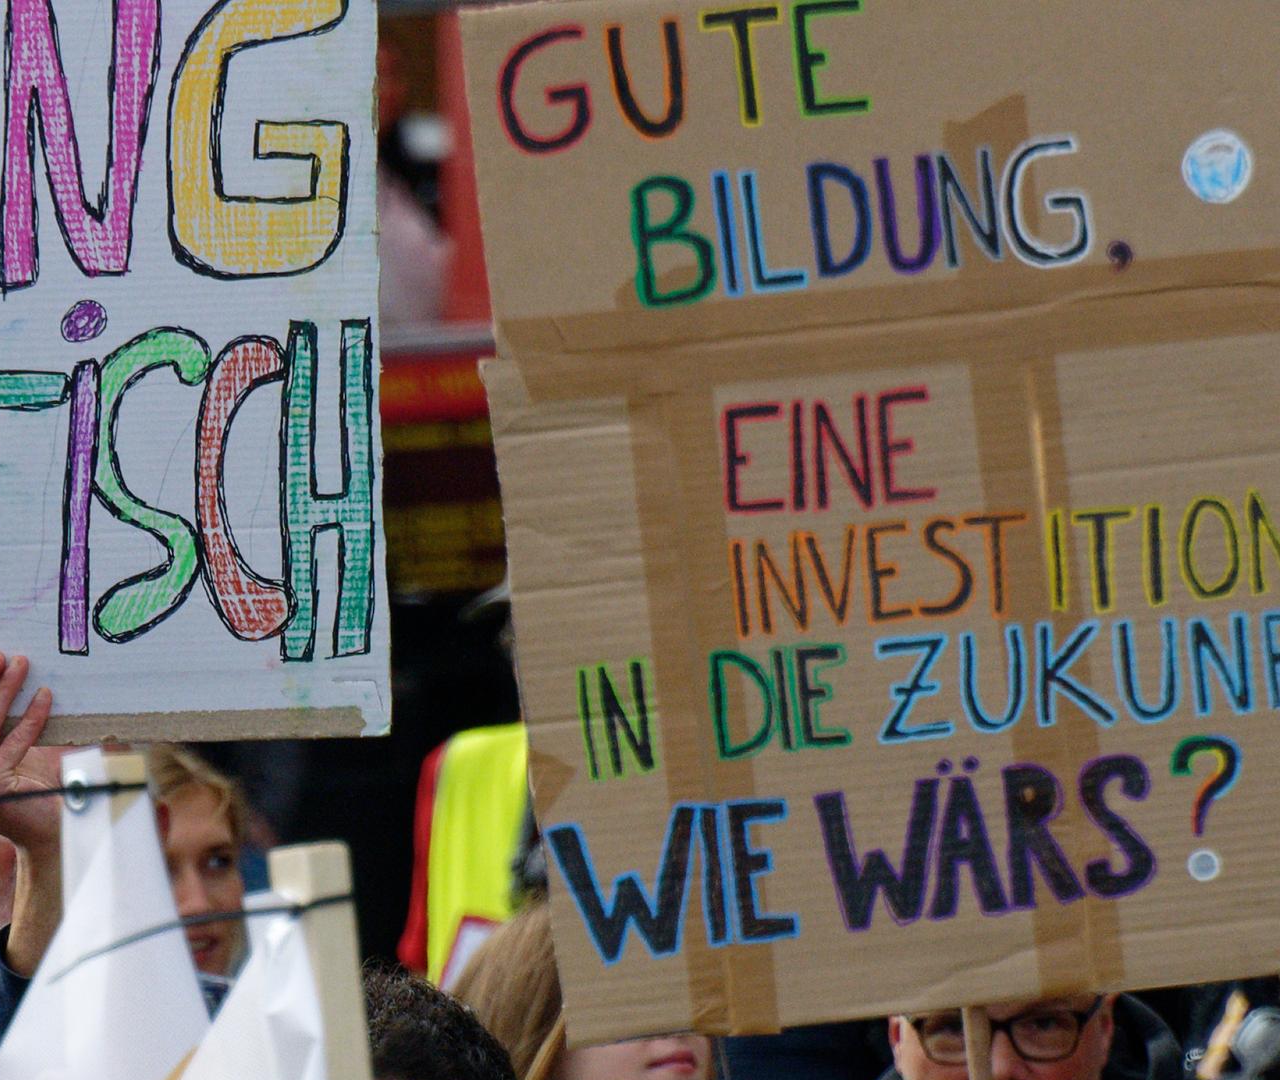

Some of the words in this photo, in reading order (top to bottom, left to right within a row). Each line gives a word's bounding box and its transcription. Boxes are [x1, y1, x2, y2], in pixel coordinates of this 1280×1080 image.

[497, 0, 871, 155] GUTE
[629, 132, 1133, 308] BILDUNG,
[724, 385, 937, 515] EINE
[577, 659, 658, 781] IN
[709, 642, 853, 761] DIE
[542, 798, 801, 965] WIE
